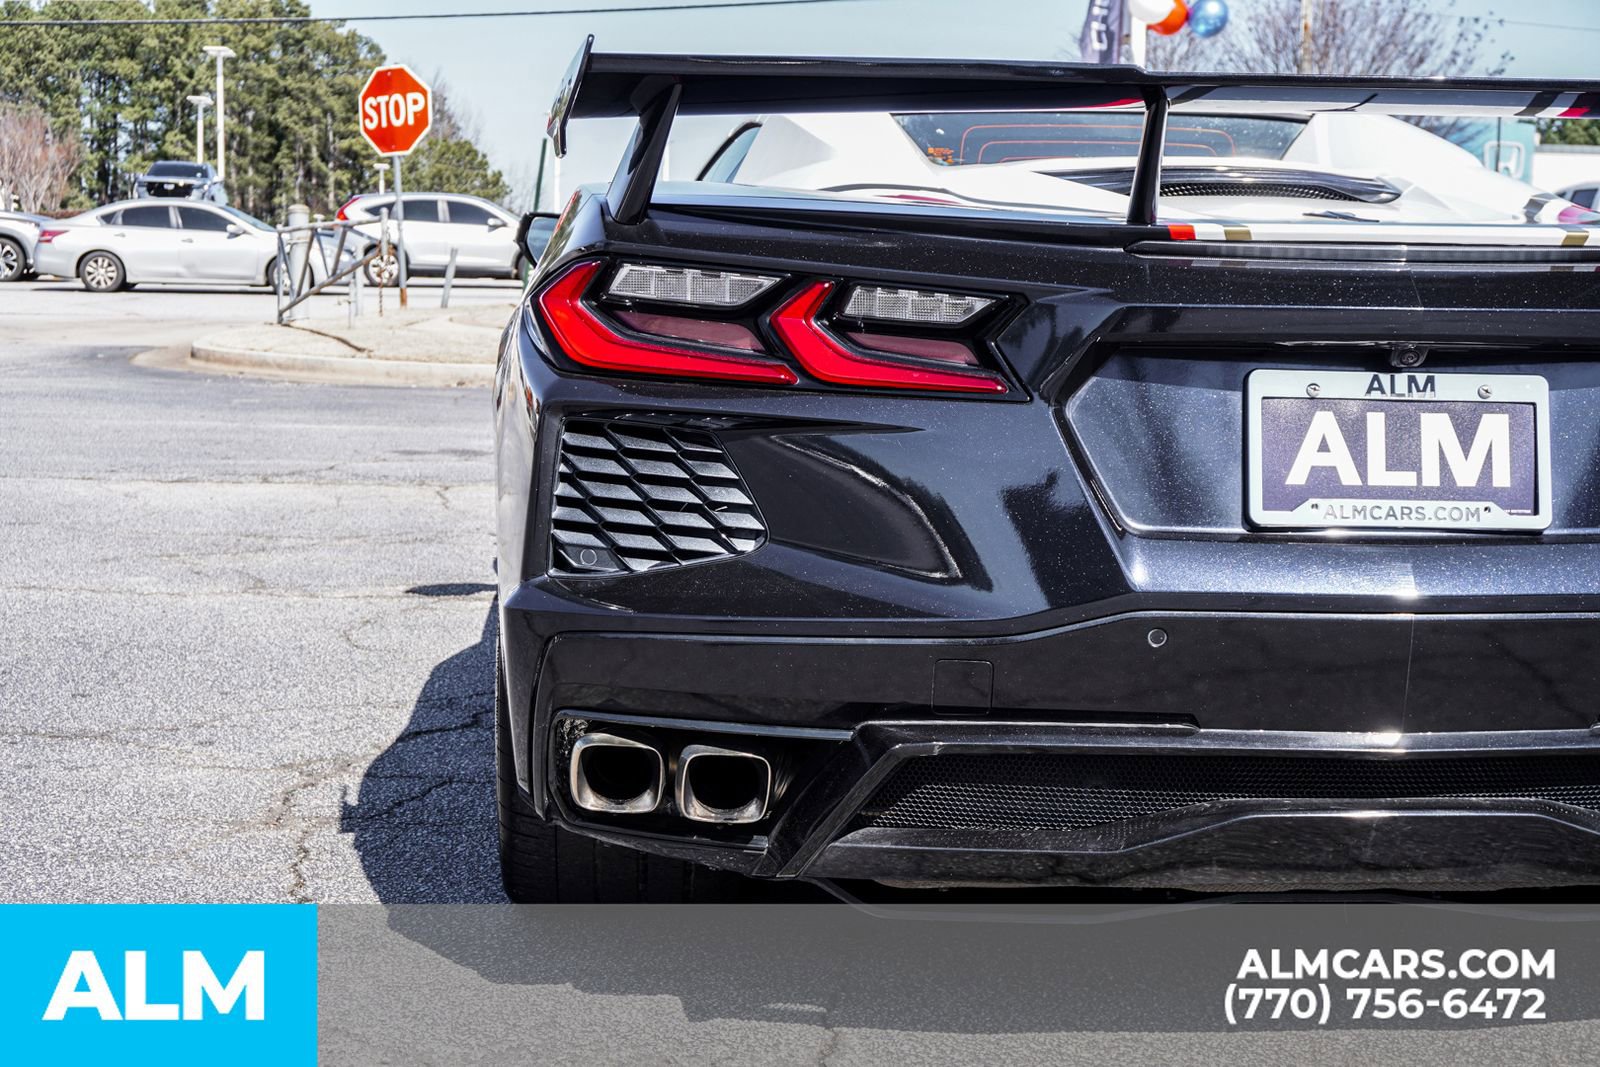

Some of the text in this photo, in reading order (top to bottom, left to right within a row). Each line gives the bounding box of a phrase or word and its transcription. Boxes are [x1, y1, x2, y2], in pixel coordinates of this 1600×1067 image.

[364, 92, 426, 131] STOP
[1365, 373, 1437, 398] ALM
[1285, 411, 1511, 487] ALM
[1323, 504, 1481, 522] ALMCARS.COM
